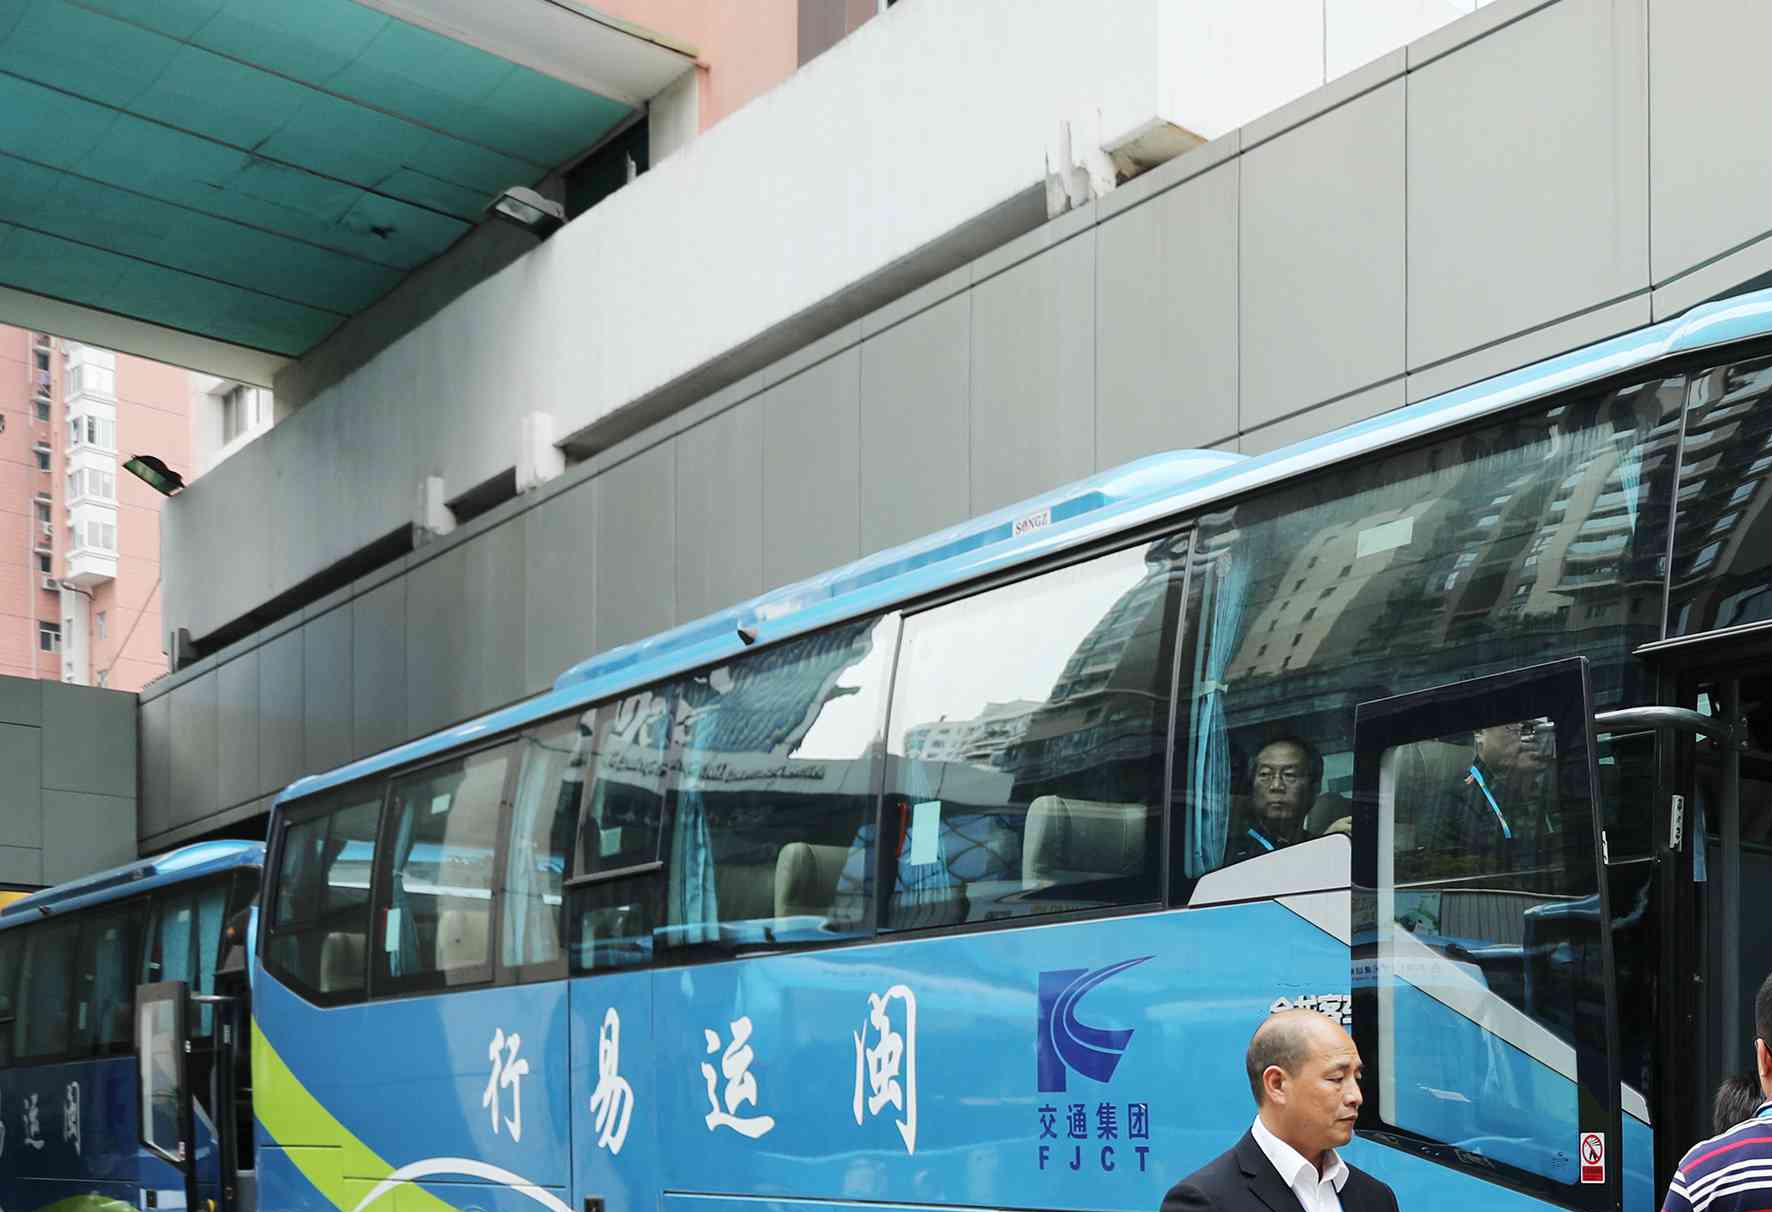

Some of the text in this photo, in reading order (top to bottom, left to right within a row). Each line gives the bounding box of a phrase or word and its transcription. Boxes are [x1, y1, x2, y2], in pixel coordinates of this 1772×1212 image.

[1038, 1102, 1150, 1140] 交通集团
[1038, 1145, 1150, 1172] FJCT
